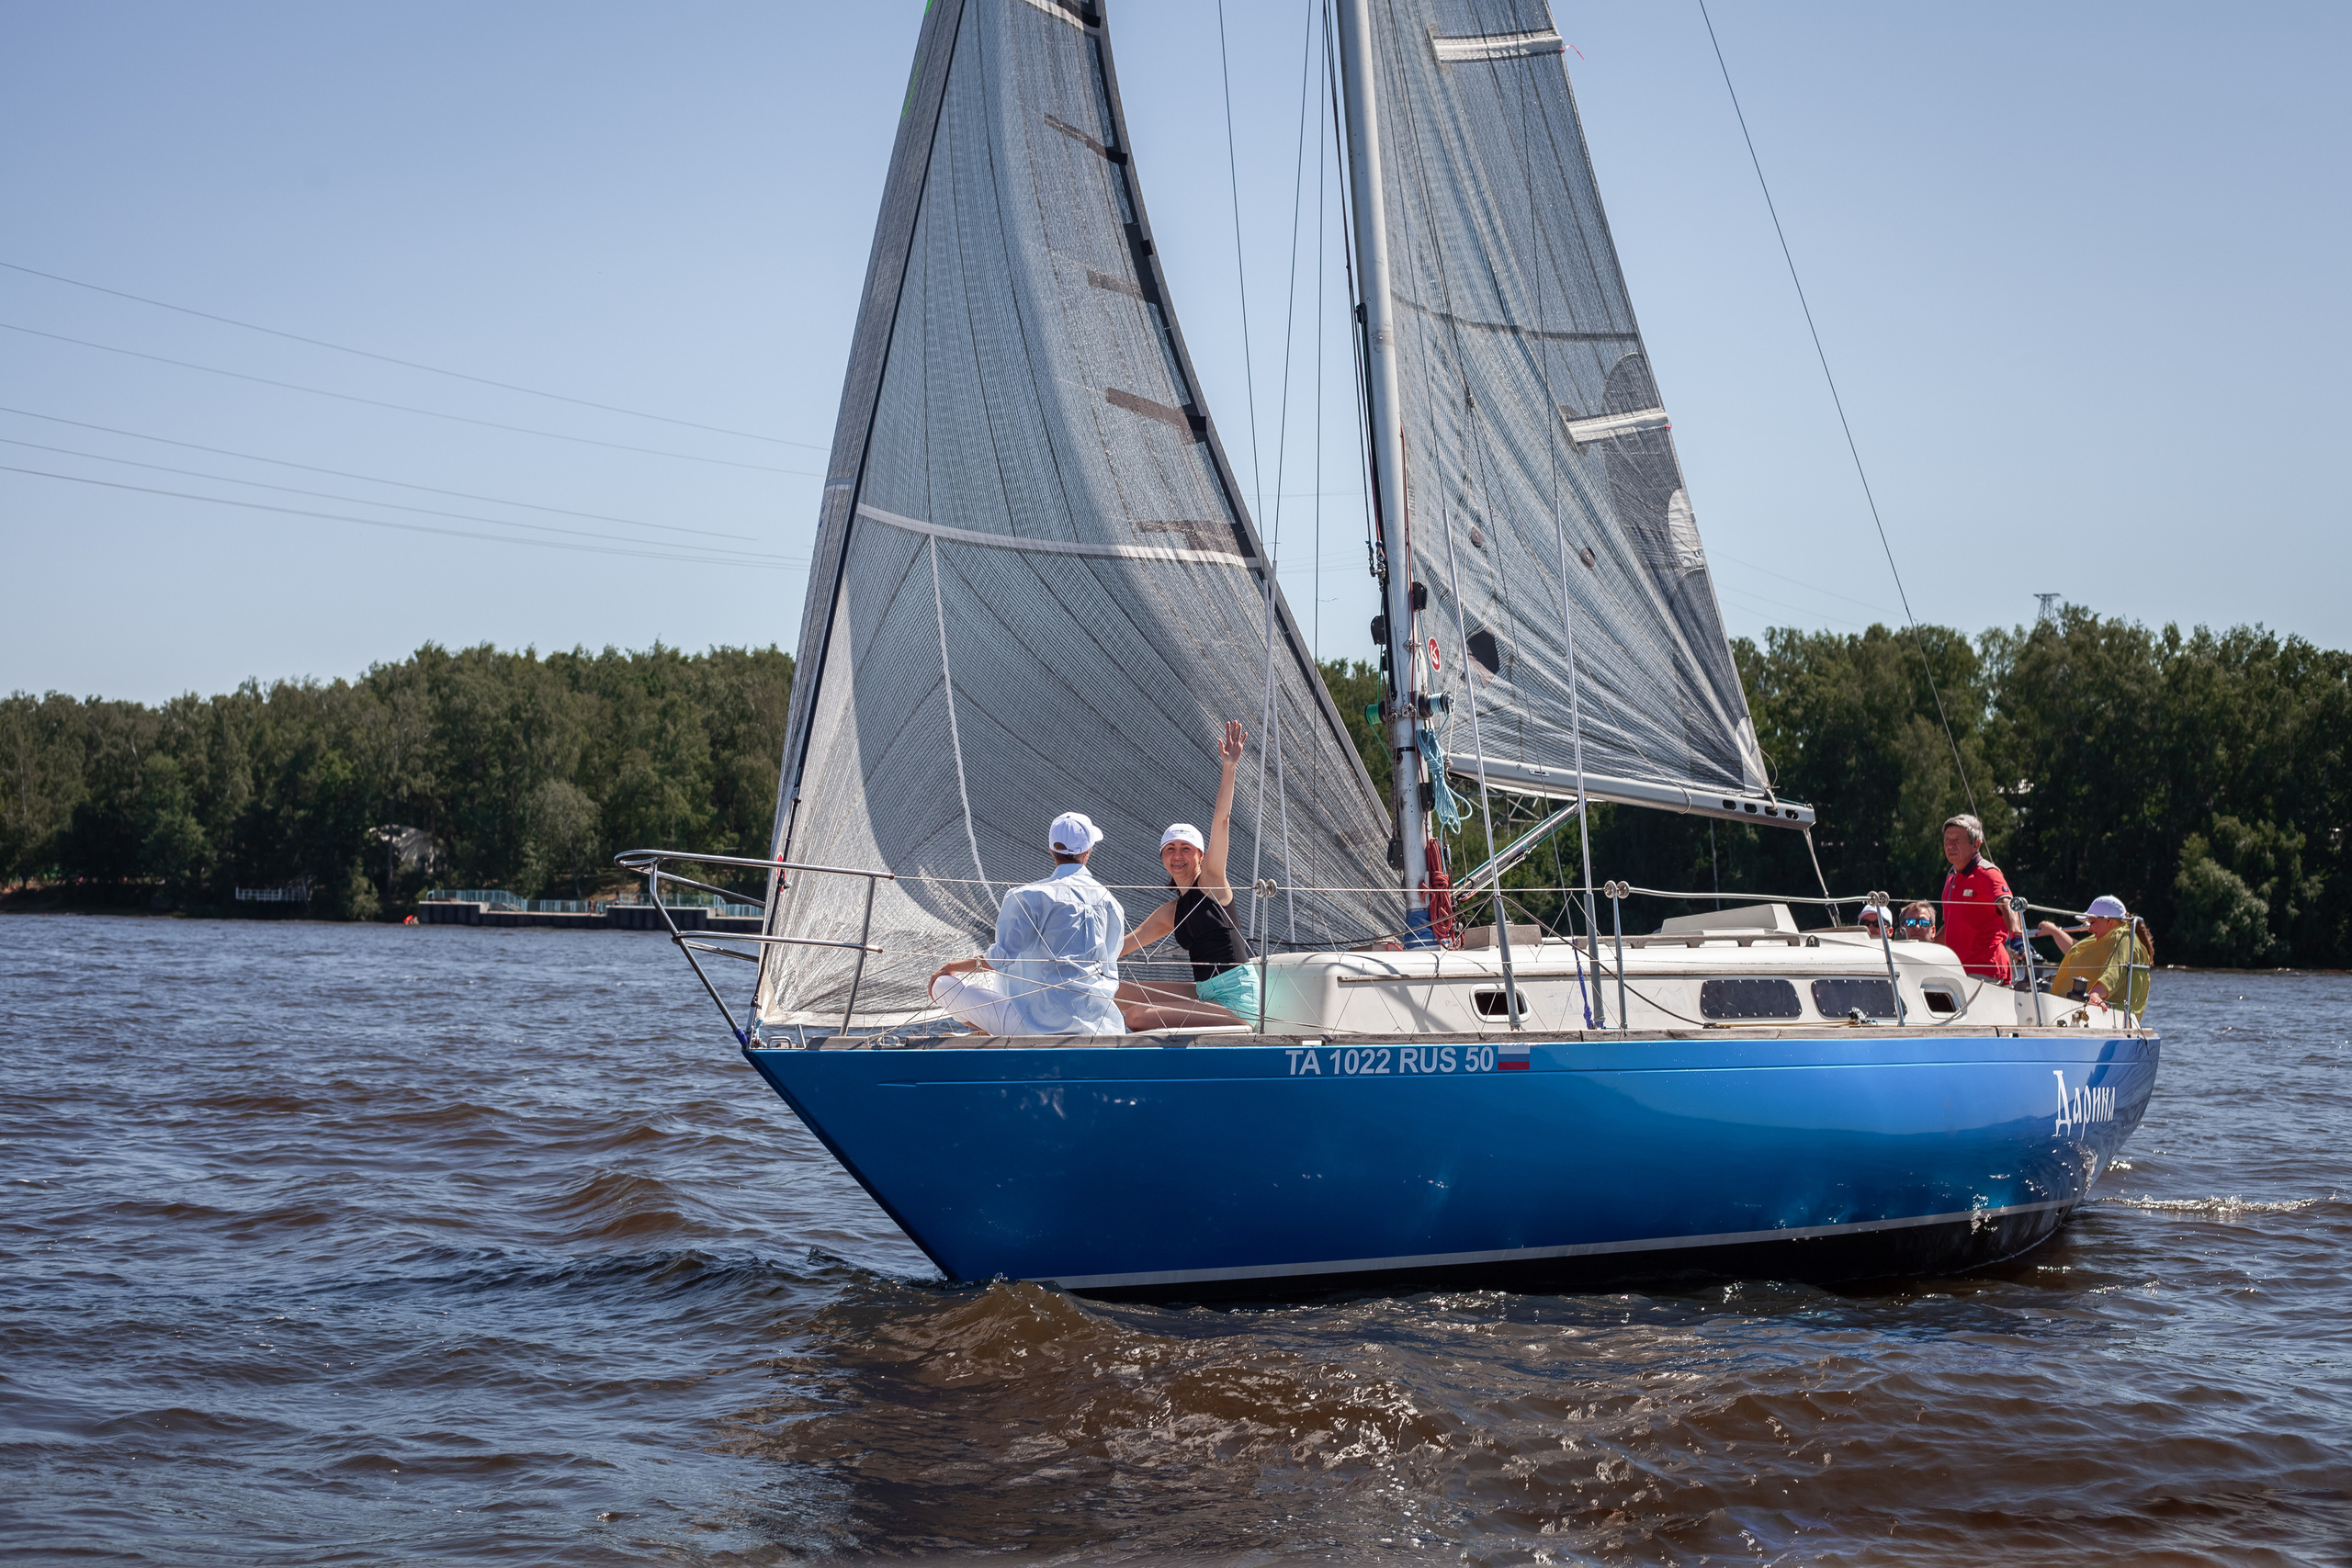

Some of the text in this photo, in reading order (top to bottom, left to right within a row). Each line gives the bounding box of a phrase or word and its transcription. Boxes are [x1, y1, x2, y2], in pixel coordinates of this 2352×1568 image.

[1329, 1048, 1391, 1075] 1022
[1398, 1046, 1457, 1074] RUS
[1464, 1045, 1494, 1073] 50
[2052, 1070, 2116, 1142] Дарина
